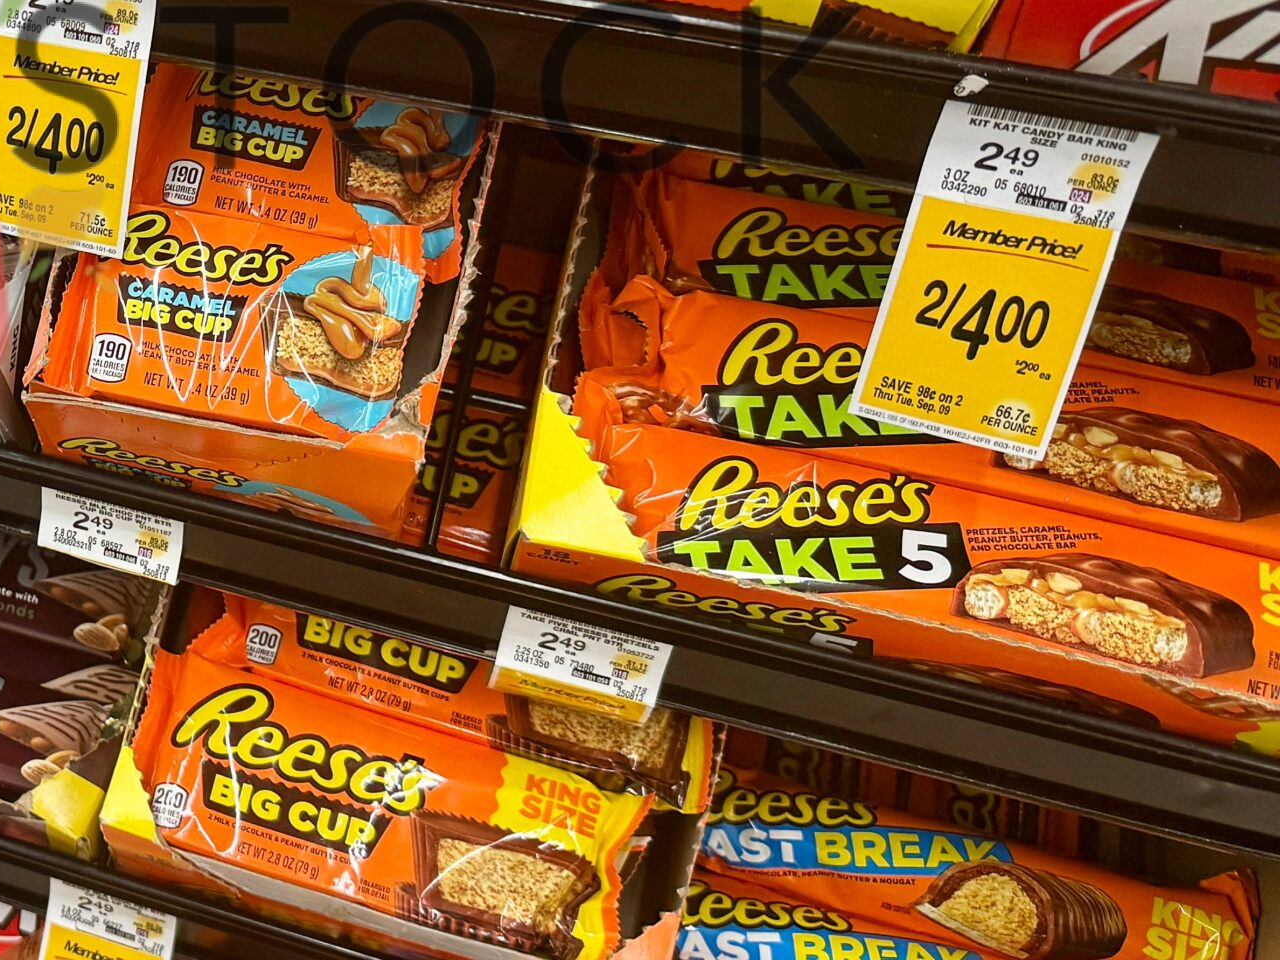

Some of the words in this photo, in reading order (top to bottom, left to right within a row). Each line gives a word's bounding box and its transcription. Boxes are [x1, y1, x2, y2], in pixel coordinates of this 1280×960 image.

[13, 54, 74, 78] Member
[77, 66, 120, 86] Price!
[201, 110, 308, 145] CARAMEL
[969, 117, 991, 130] KIT
[993, 121, 1019, 135] KAT
[1021, 125, 1066, 142] CANDY
[1067, 133, 1095, 148] BAR
[1096, 138, 1128, 153] KING
[1030, 136, 1059, 149] SIZE
[197, 127, 241, 152] BIG
[246, 140, 303, 164] CUP
[170, 165, 199, 186] 190
[940, 179, 988, 197] 0342290
[942, 219, 1028, 251] Member
[1027, 236, 1084, 260] Price!
[872, 386, 894, 403] Thru
[896, 392, 915, 409] Tue.
[917, 398, 936, 415] Sep.
[938, 404, 951, 417] 09
[880, 375, 914, 395] SAVE
[939, 392, 953, 404] on
[954, 394, 964, 407] 2
[980, 414, 1002, 427] PER
[1004, 417, 1038, 437] OUNCE
[56, 493, 87, 507] REESES
[89, 502, 107, 511] MLK
[109, 507, 133, 518] CHOC
[135, 513, 152, 522] PNT
[154, 519, 172, 527] BTR
[678, 459, 933, 531] Reese's
[966, 526, 1018, 538] PRETZELS,
[1020, 525, 1072, 537] CARAMEL,
[967, 533, 1007, 544] PEANUT
[1051, 531, 1103, 543] PEANUTS,
[970, 542, 991, 552] AND
[993, 541, 1054, 553] CHOCOLATE
[1056, 540, 1078, 551] BAR
[674, 537, 885, 585] TAKE
[897, 529, 953, 584] 5
[520, 613, 545, 623] TAKE
[548, 620, 568, 628] FIVE
[571, 624, 607, 639] REESES
[611, 634, 659, 651] PRETZELS
[524, 773, 602, 812] KING
[210, 773, 282, 821] BIG
[288, 799, 377, 852] CUP
[519, 797, 598, 838] SIZE
[815, 832, 997, 869] BREAK
